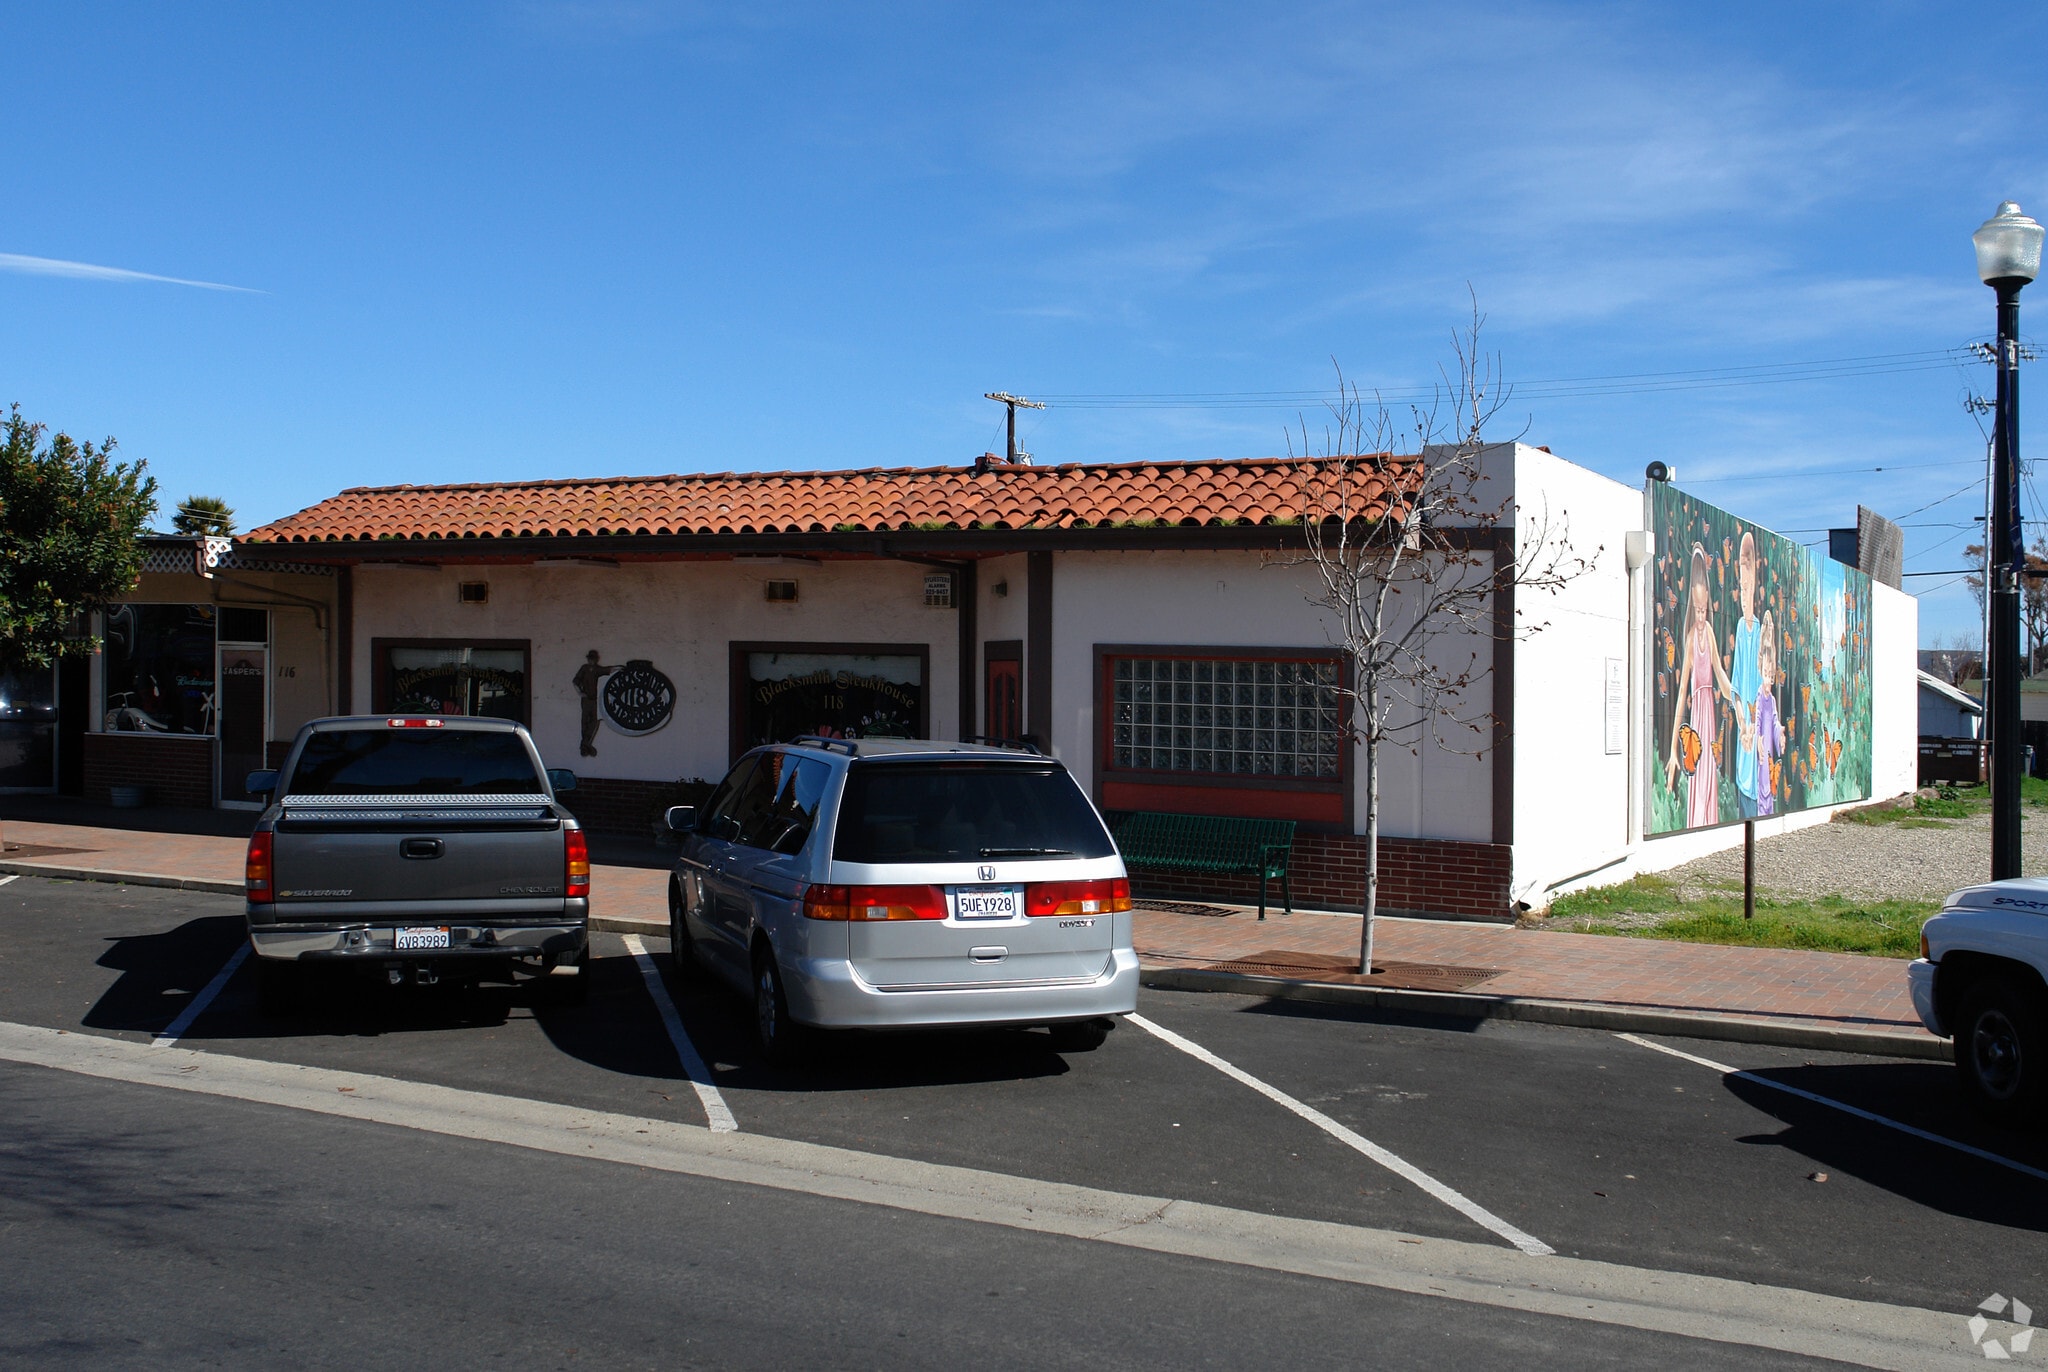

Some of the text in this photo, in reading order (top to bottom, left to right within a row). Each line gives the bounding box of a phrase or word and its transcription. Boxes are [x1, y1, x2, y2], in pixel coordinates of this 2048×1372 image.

[222, 667, 262, 676] JASPER'S
[278, 666, 296, 678] 116
[396, 662, 523, 697] Blacksmith Steakhouse
[449, 685, 467, 698] 118
[754, 669, 916, 709] Blacksmith Steakhouse
[625, 687, 648, 708] 118
[823, 694, 845, 710] 118
[293, 889, 353, 897] SILVERADO
[499, 886, 559, 894] CHEVROLET
[961, 897, 1012, 912] 5UEY928
[398, 935, 447, 949] 6V83989
